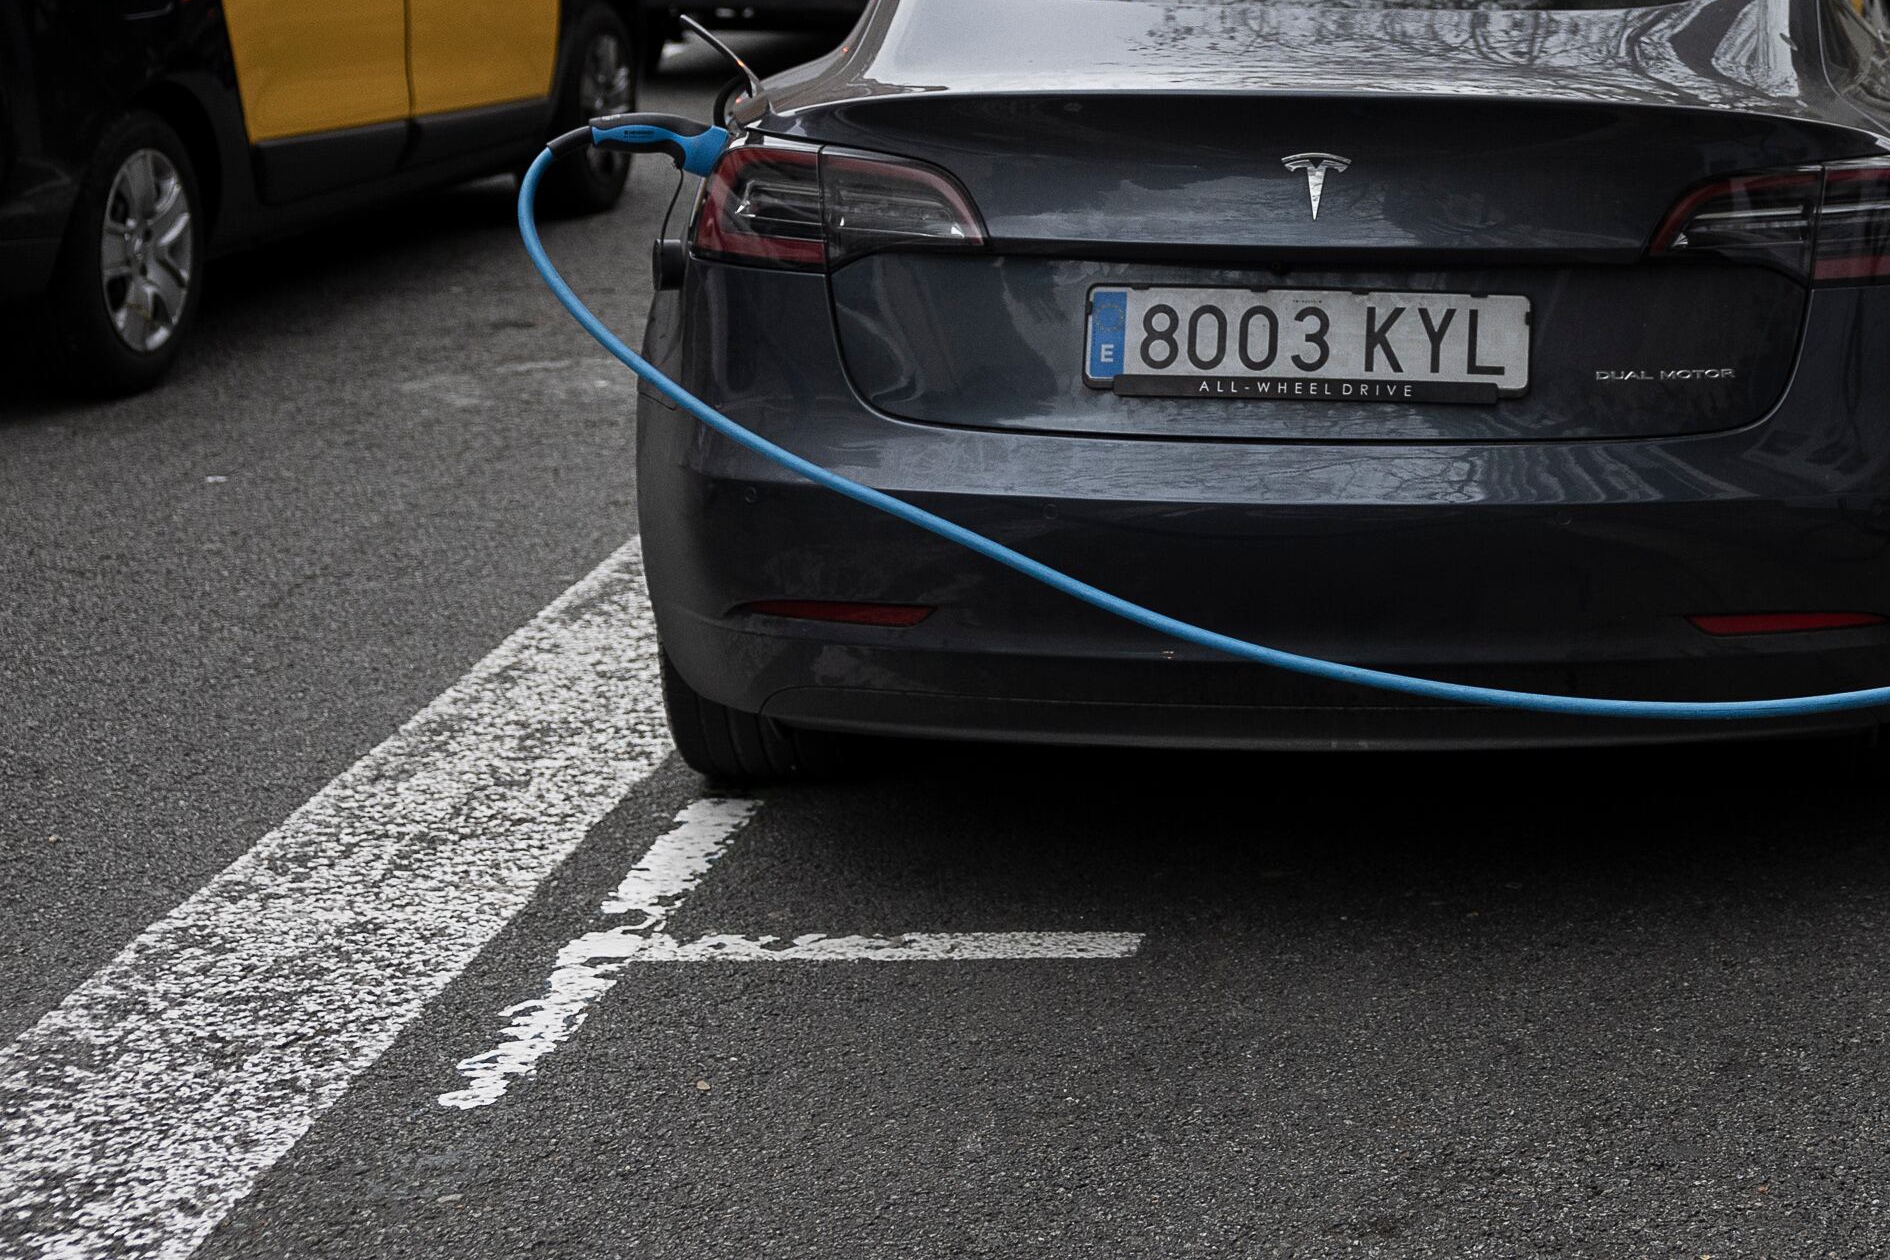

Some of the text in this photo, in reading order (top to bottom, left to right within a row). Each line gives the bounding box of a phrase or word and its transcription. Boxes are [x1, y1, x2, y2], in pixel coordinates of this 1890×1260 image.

[1140, 303, 1505, 375] 8003 KYL
[1100, 344, 1114, 362] E
[1596, 368, 1735, 380] DUAL MOTOR
[1199, 380, 1413, 397] ALL-WHEEL DRIVE
